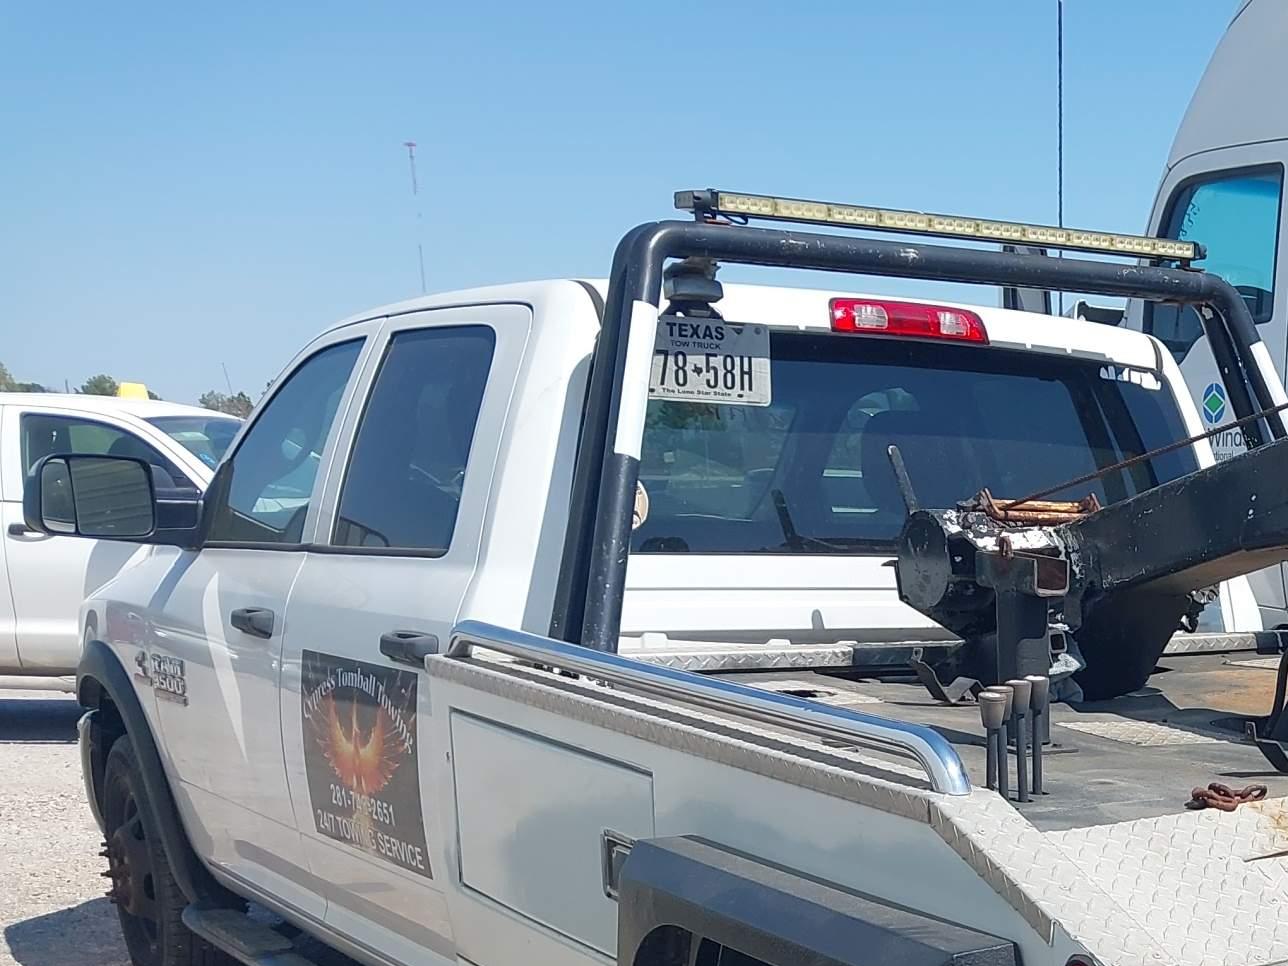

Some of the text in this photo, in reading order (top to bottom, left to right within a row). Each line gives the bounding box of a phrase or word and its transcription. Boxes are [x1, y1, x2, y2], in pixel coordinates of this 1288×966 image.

[665, 321, 726, 341] TEXAS
[670, 338, 722, 351] TOW TRUCK
[303, 666, 414, 755] Cypress Tomball Towing
[335, 814, 377, 850] TOWING
[376, 832, 425, 870] SERVICE
